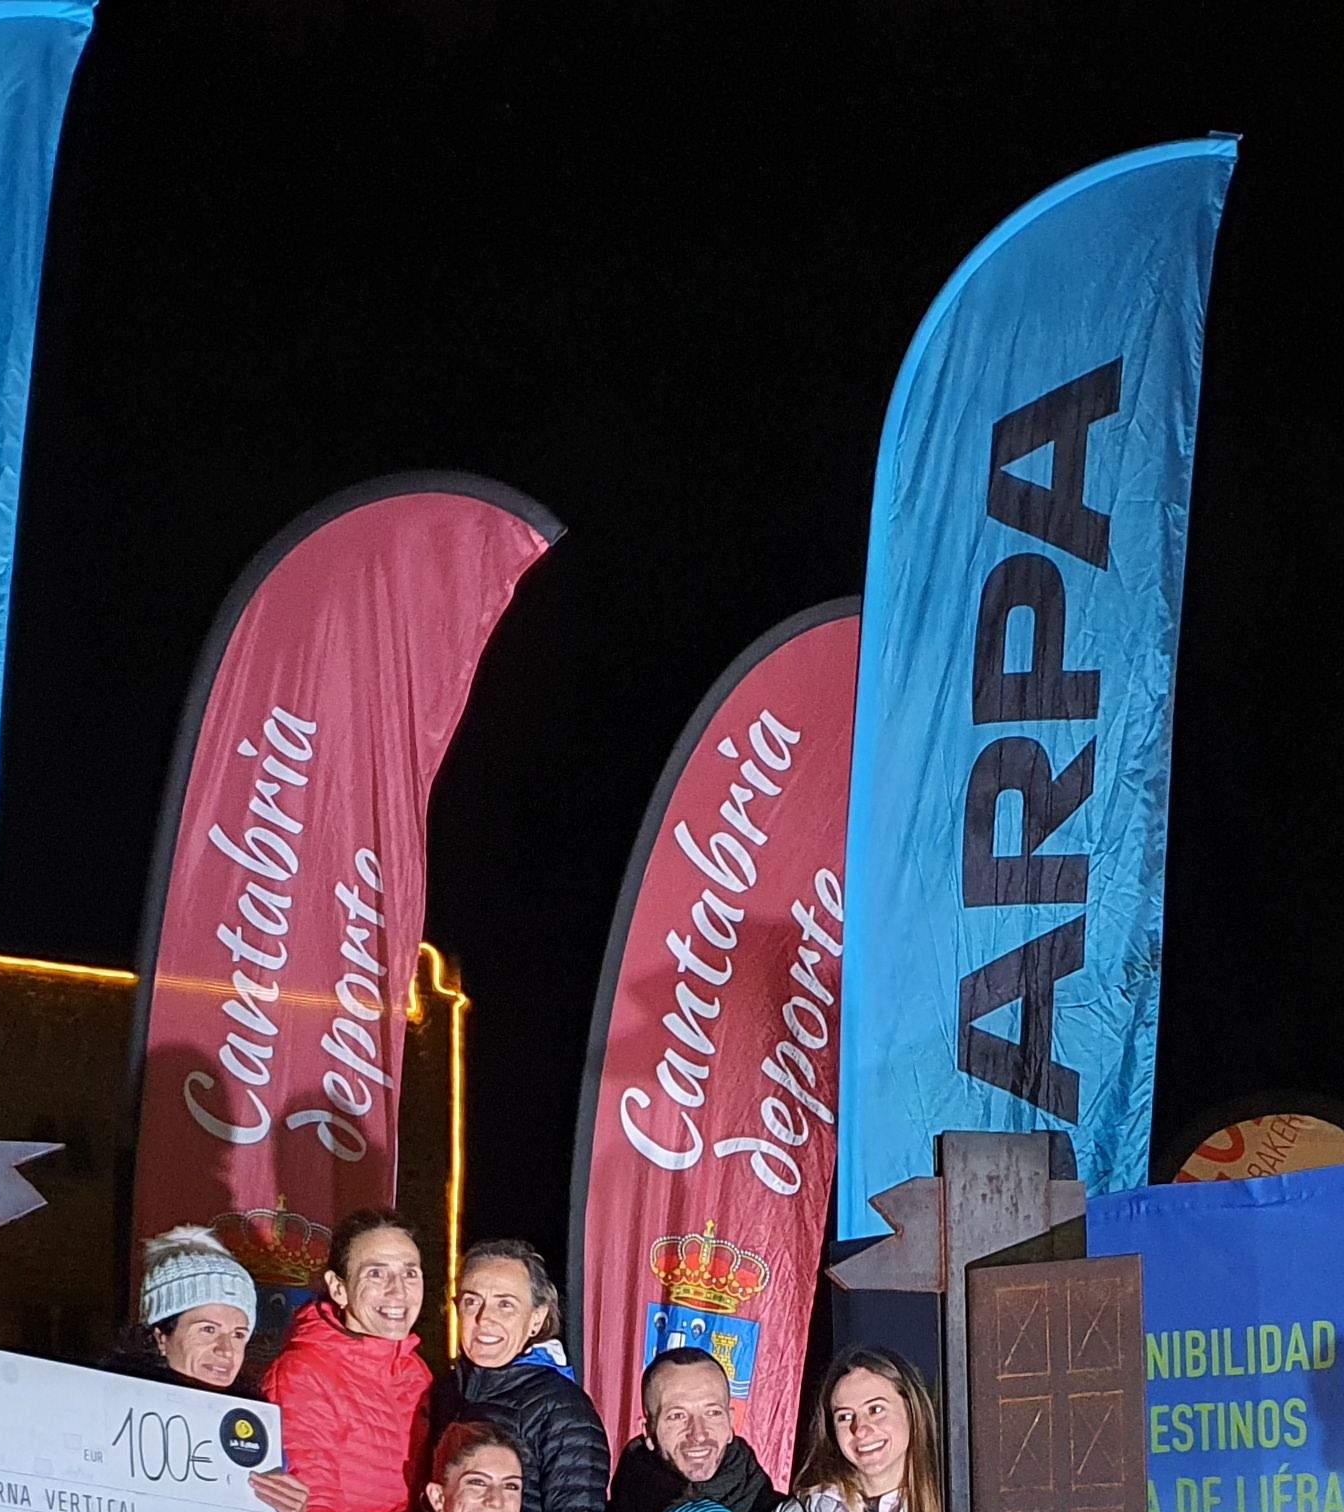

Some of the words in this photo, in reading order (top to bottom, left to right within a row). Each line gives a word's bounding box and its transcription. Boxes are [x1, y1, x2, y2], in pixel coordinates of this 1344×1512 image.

[957, 354, 1123, 1145] ARPA
[184, 706, 318, 1145] Cantabria
[287, 846, 394, 1162] deporte
[620, 708, 804, 1171] Cantabria
[713, 866, 845, 1196] deporte
[84, 1449, 103, 1463] EUR
[1146, 1320, 1336, 1381] NIBILIDAD
[1149, 1398, 1309, 1454] ESTINOS
